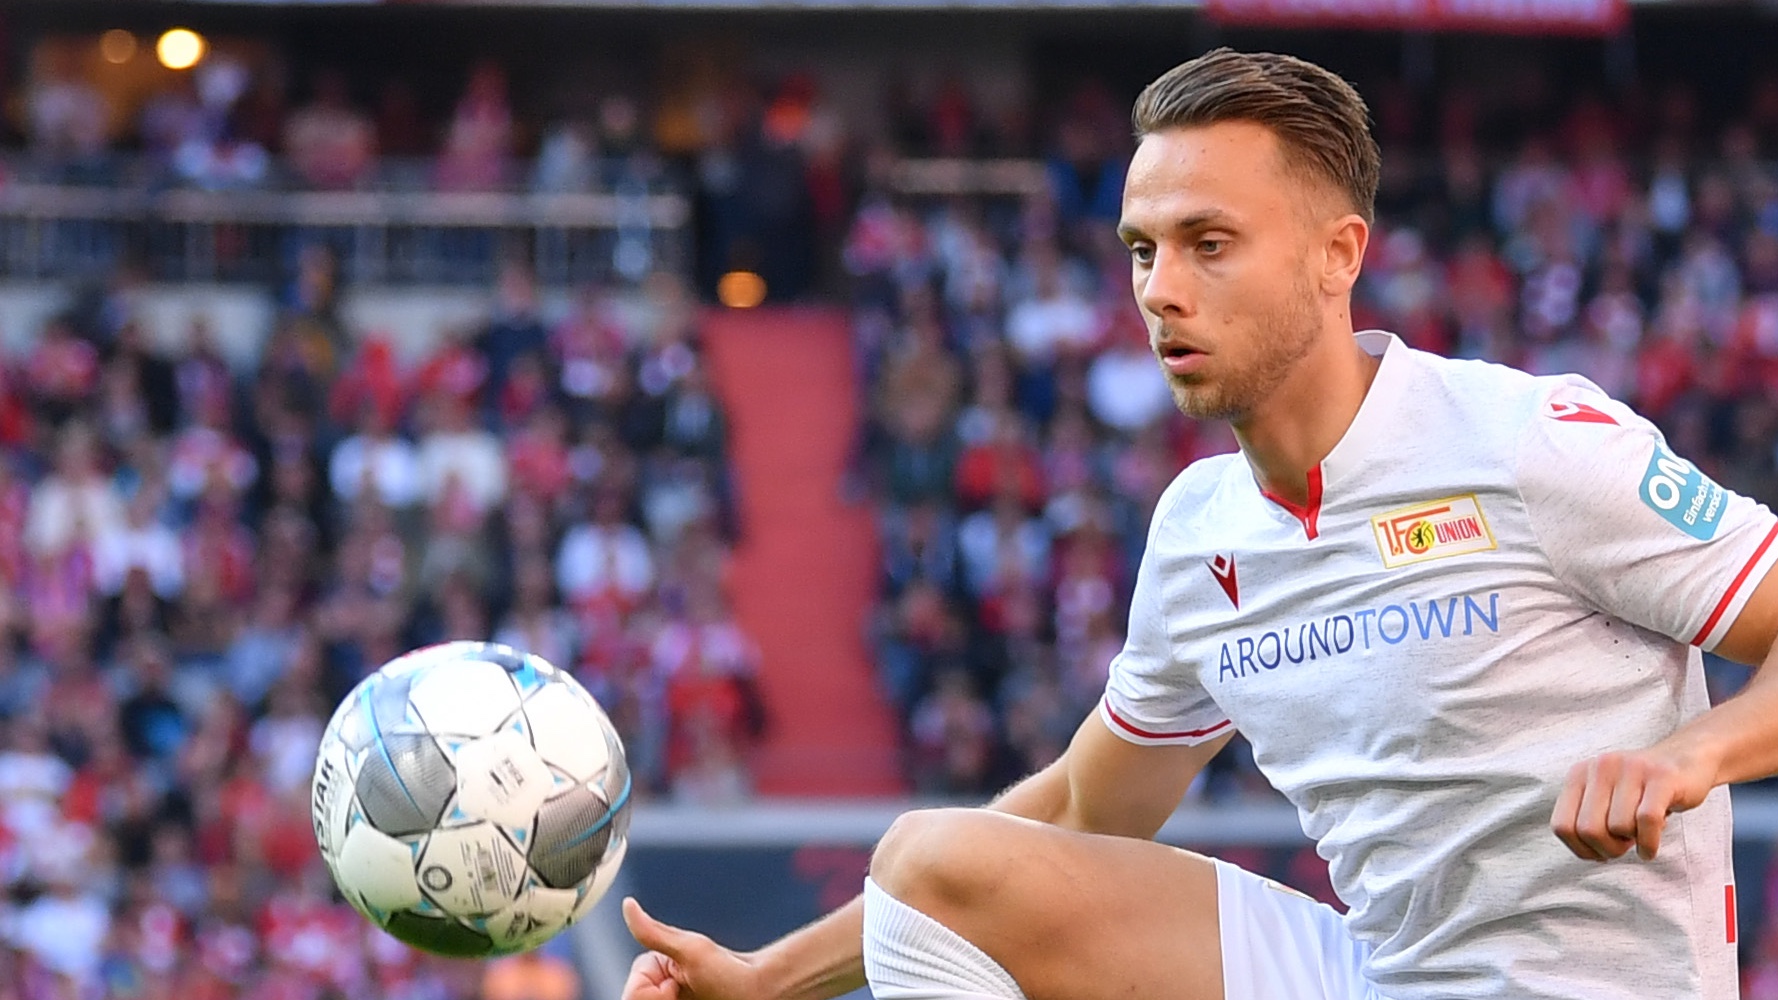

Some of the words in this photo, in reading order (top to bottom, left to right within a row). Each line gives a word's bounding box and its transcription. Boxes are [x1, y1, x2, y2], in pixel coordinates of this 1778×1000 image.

[1648, 448, 1692, 510] ON
[1434, 516, 1482, 543] UNION
[1219, 593, 1499, 683] AROUNDTOWN
